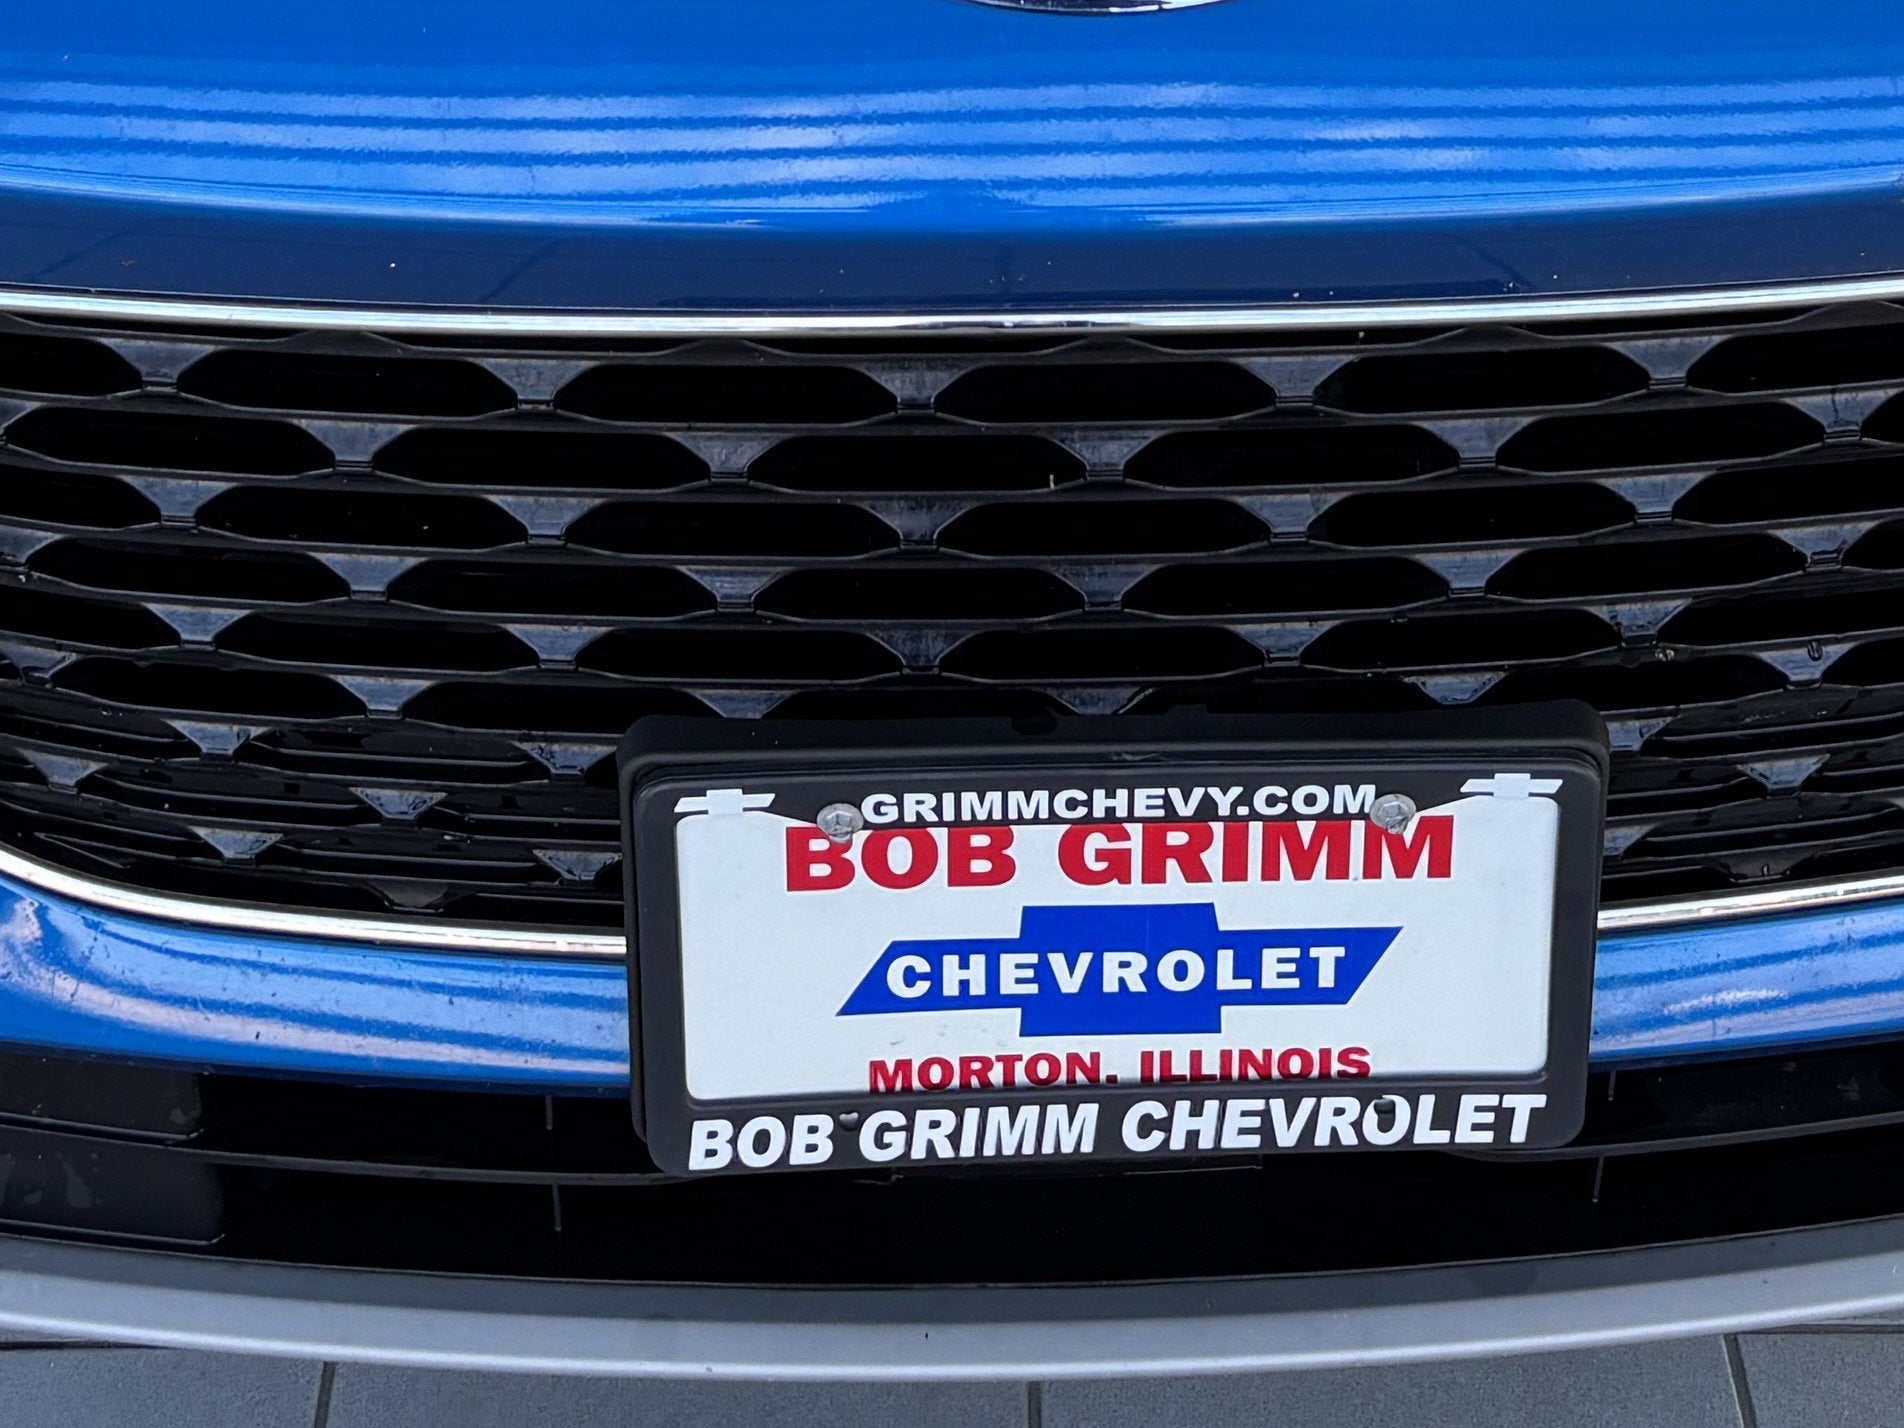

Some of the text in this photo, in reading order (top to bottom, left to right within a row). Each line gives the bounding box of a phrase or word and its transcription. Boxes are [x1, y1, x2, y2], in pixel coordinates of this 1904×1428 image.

[860, 783, 1377, 825] GRIMMCHEVY.COM
[785, 814, 1454, 892] BOB GRIMM
[885, 945, 1346, 999] CHEVROLET
[1139, 1046, 1371, 1084] ILLINOIS
[688, 1093, 1547, 1171] BOB GRIMM CHEVROLET
